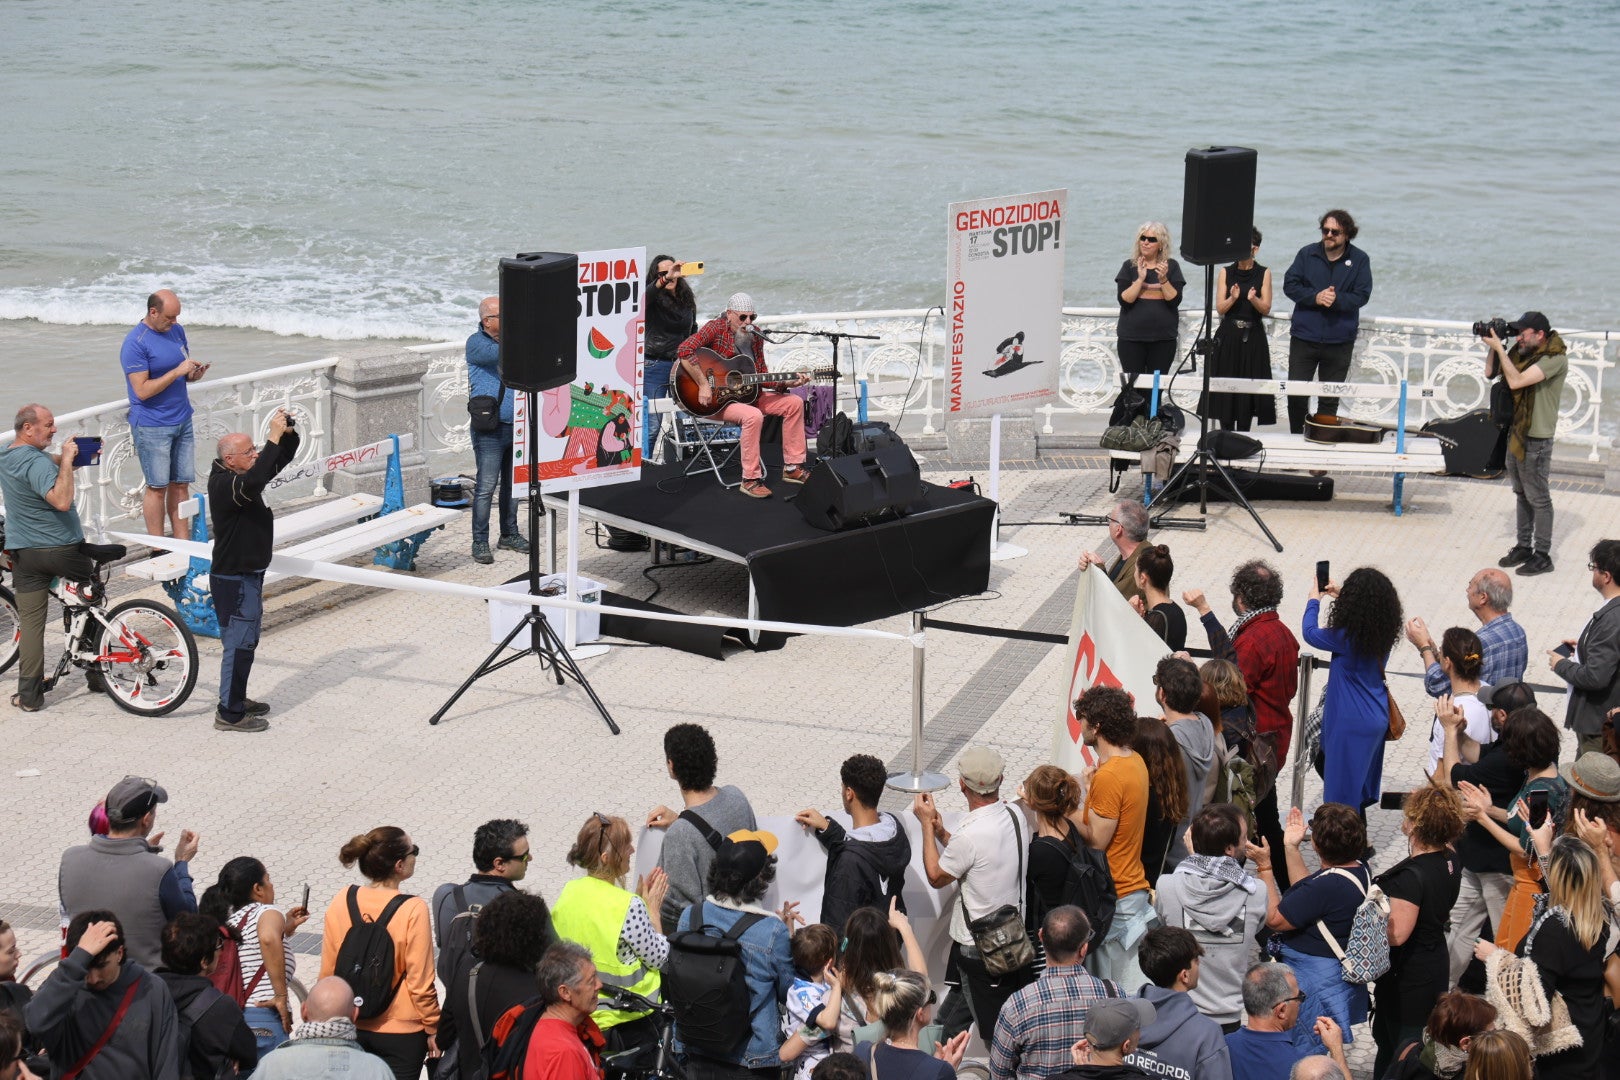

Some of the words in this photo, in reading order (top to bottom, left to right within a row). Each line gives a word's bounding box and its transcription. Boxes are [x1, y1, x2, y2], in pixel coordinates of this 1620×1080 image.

[956, 199, 1061, 231] GENOZIDIOA
[992, 220, 1061, 258] STOP!
[578, 258, 639, 284] ZIDIOA
[950, 281, 965, 413] MANIFESTAZIO
[1136, 1055, 1191, 1080] RECORDS
